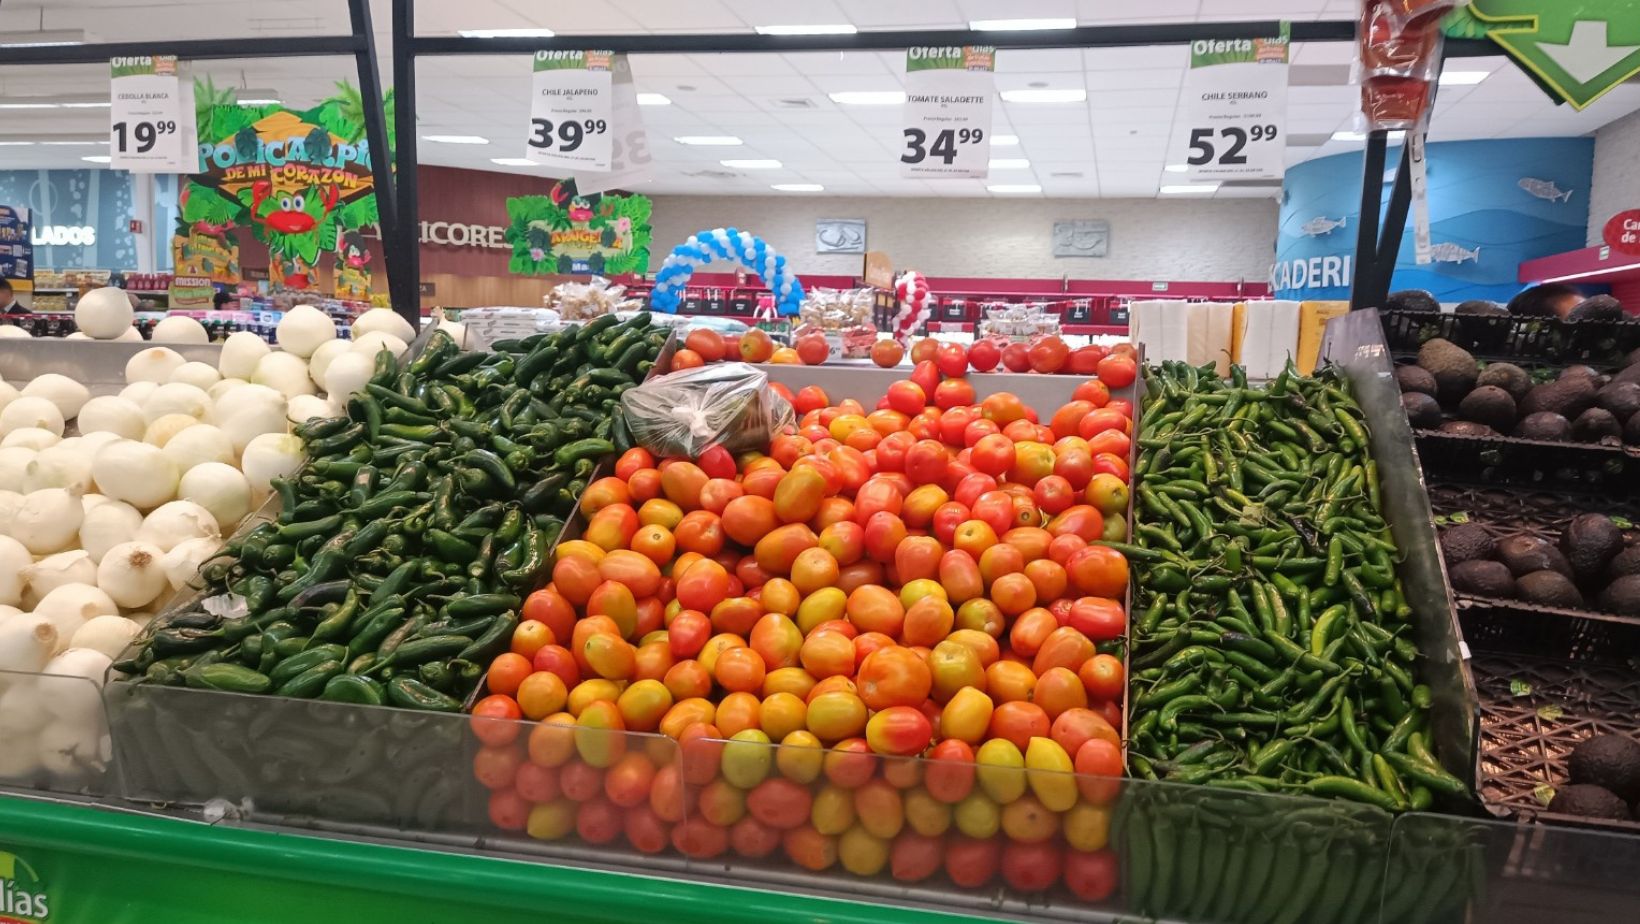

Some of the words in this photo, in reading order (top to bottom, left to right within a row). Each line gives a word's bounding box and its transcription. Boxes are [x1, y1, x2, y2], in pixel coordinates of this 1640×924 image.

[145, 92, 169, 100] BLANCA
[542, 88, 561, 96] CHILE
[1201, 92, 1225, 101] CHILE
[1227, 90, 1268, 100] SERRANO
[908, 95, 938, 103] TOMATE
[940, 95, 984, 103] SALADETTE
[225, 167, 246, 181] DE
[248, 164, 266, 179] MI
[270, 163, 358, 189] CORAZON
[31, 225, 95, 246] LADOS
[418, 220, 514, 249] ICORE
[1621, 231, 1636, 244] de
